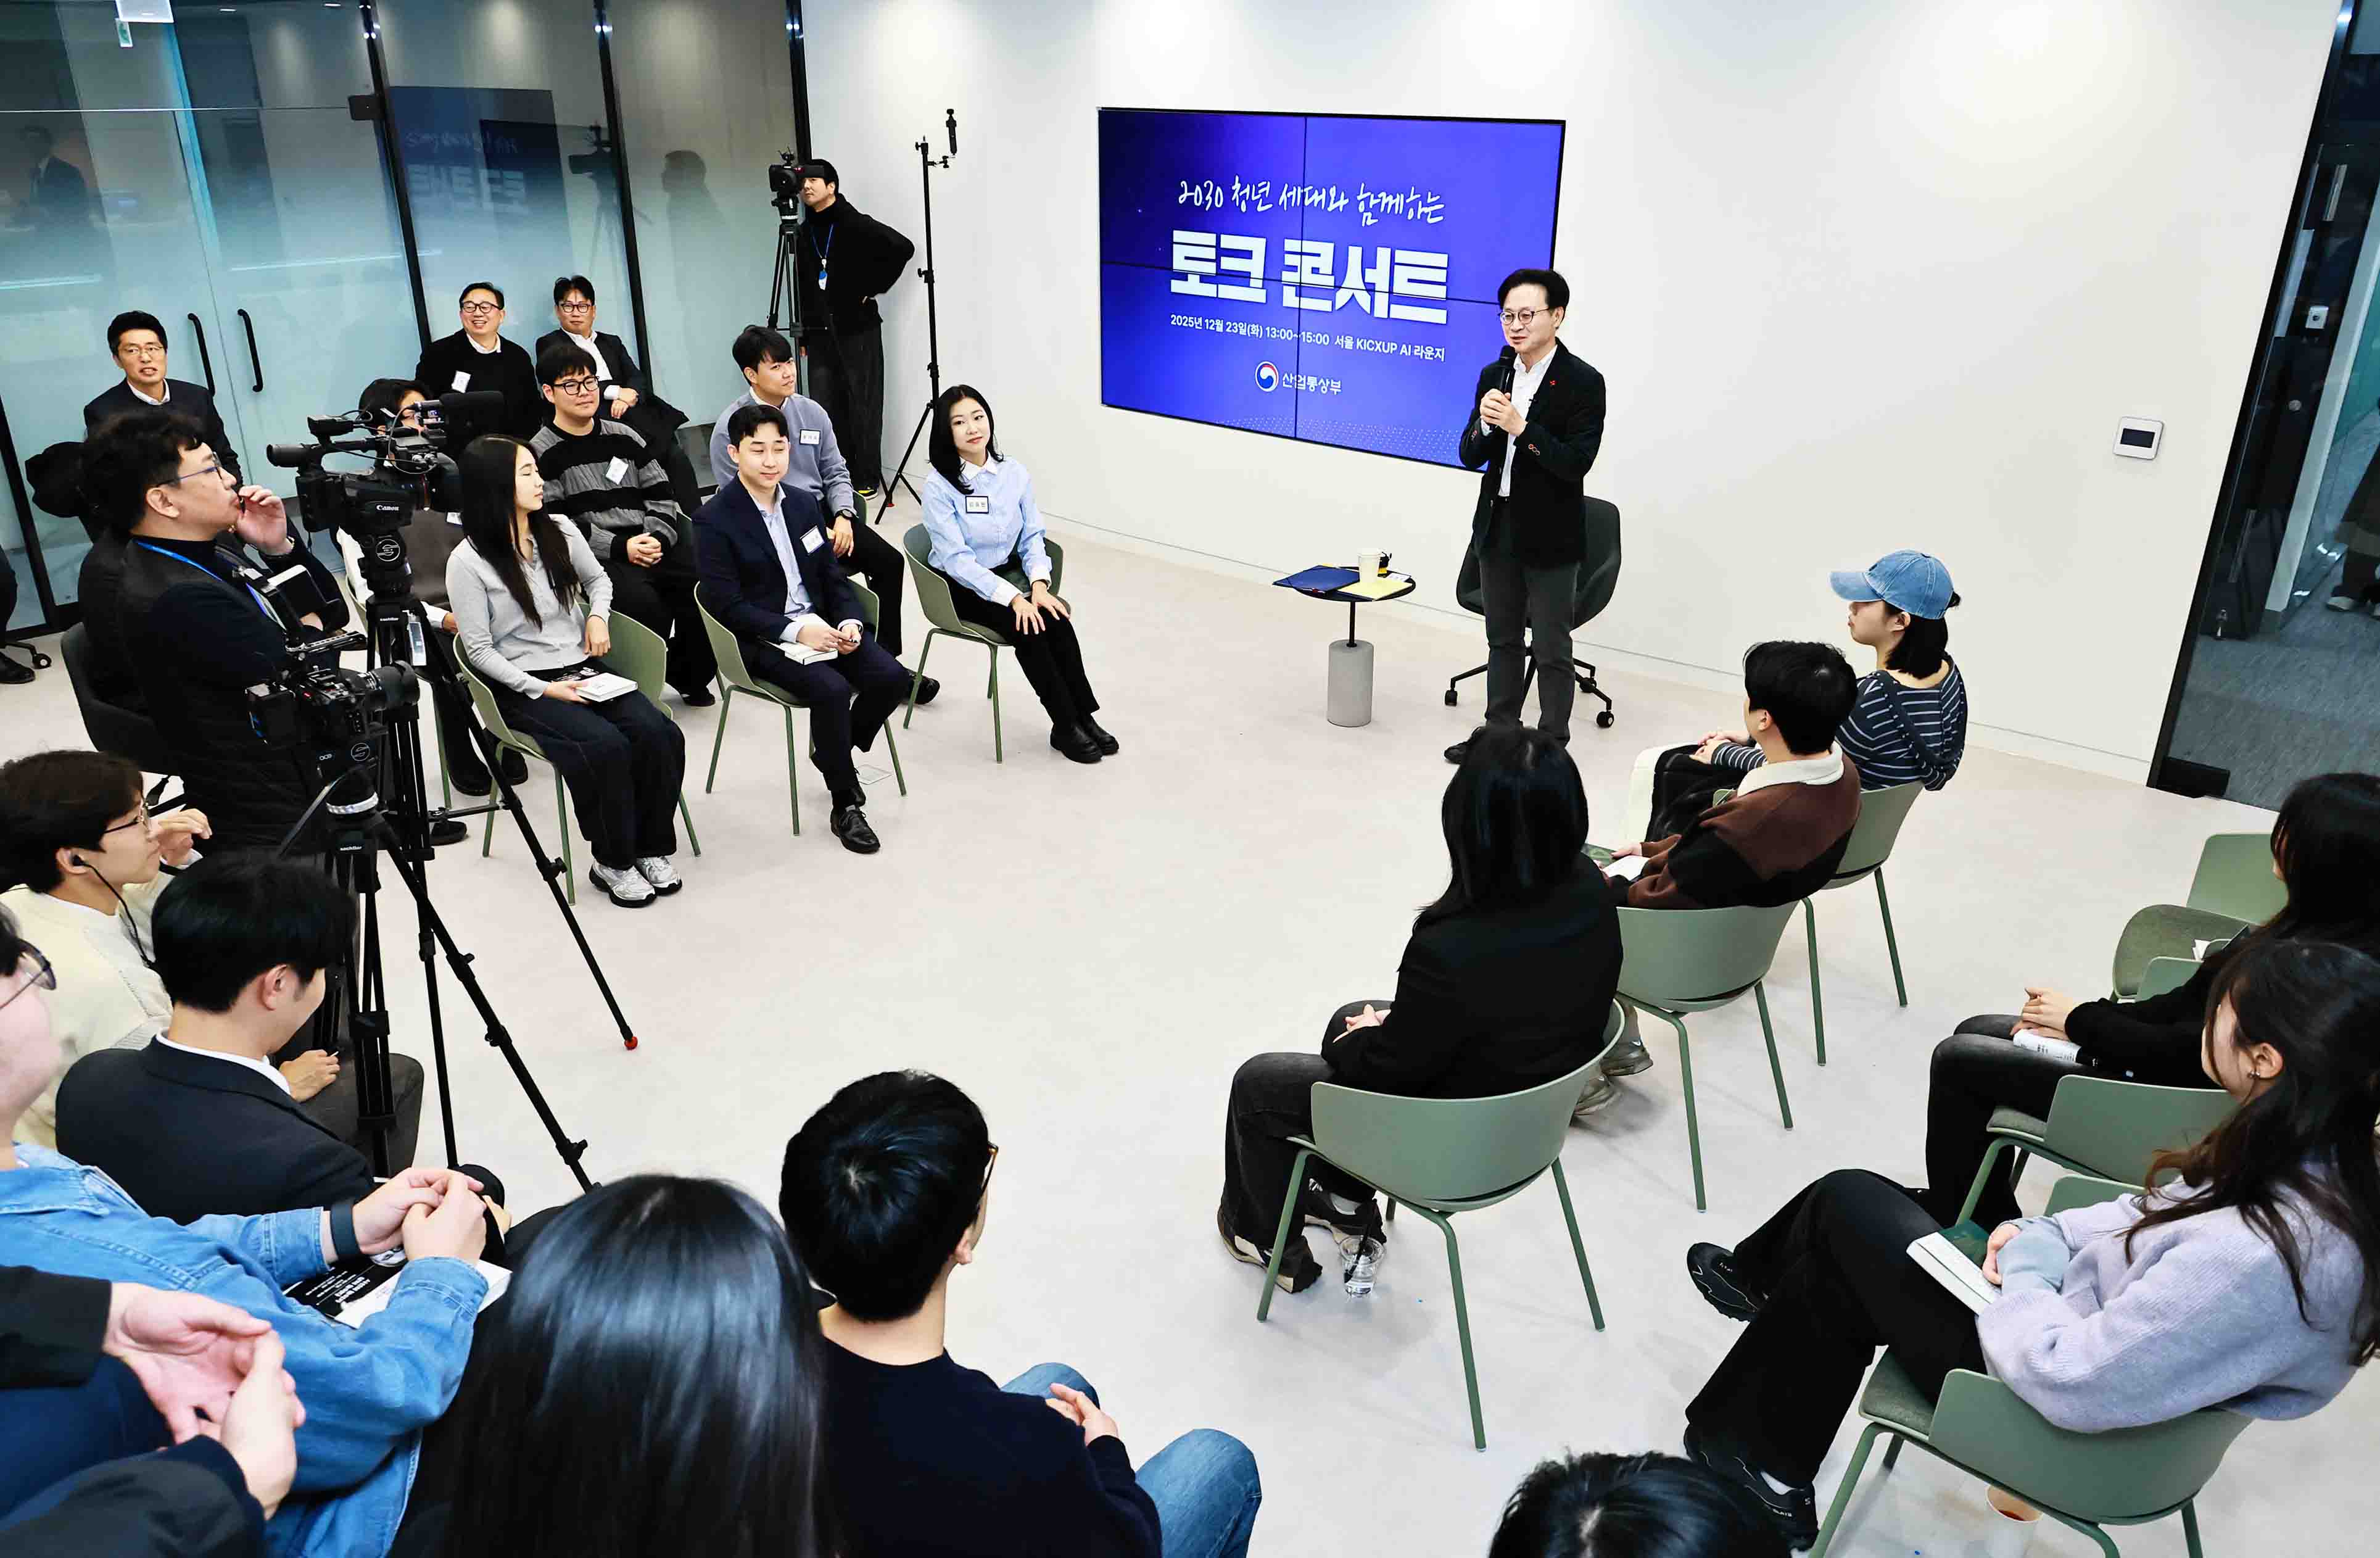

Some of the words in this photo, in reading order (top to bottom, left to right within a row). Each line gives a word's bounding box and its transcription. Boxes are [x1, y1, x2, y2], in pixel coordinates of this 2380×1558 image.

[1178, 180, 1223, 211] 2030
[1232, 175, 1273, 212] 청년
[1279, 183, 1349, 212] 세대와
[1357, 183, 1445, 226] 함께하는
[1171, 230, 1266, 304] 토크
[1281, 238, 1448, 325] 콘서트
[1170, 314, 1202, 329] 2025년
[1204, 318, 1223, 332] 12월
[1225, 321, 1263, 338] 23일(화)
[1334, 335, 1354, 350] 서울
[1357, 338, 1397, 354] KICXUP
[1400, 344, 1411, 356] AI
[1413, 345, 1445, 362] 라운지
[1282, 372, 1342, 395] 산업통상부
